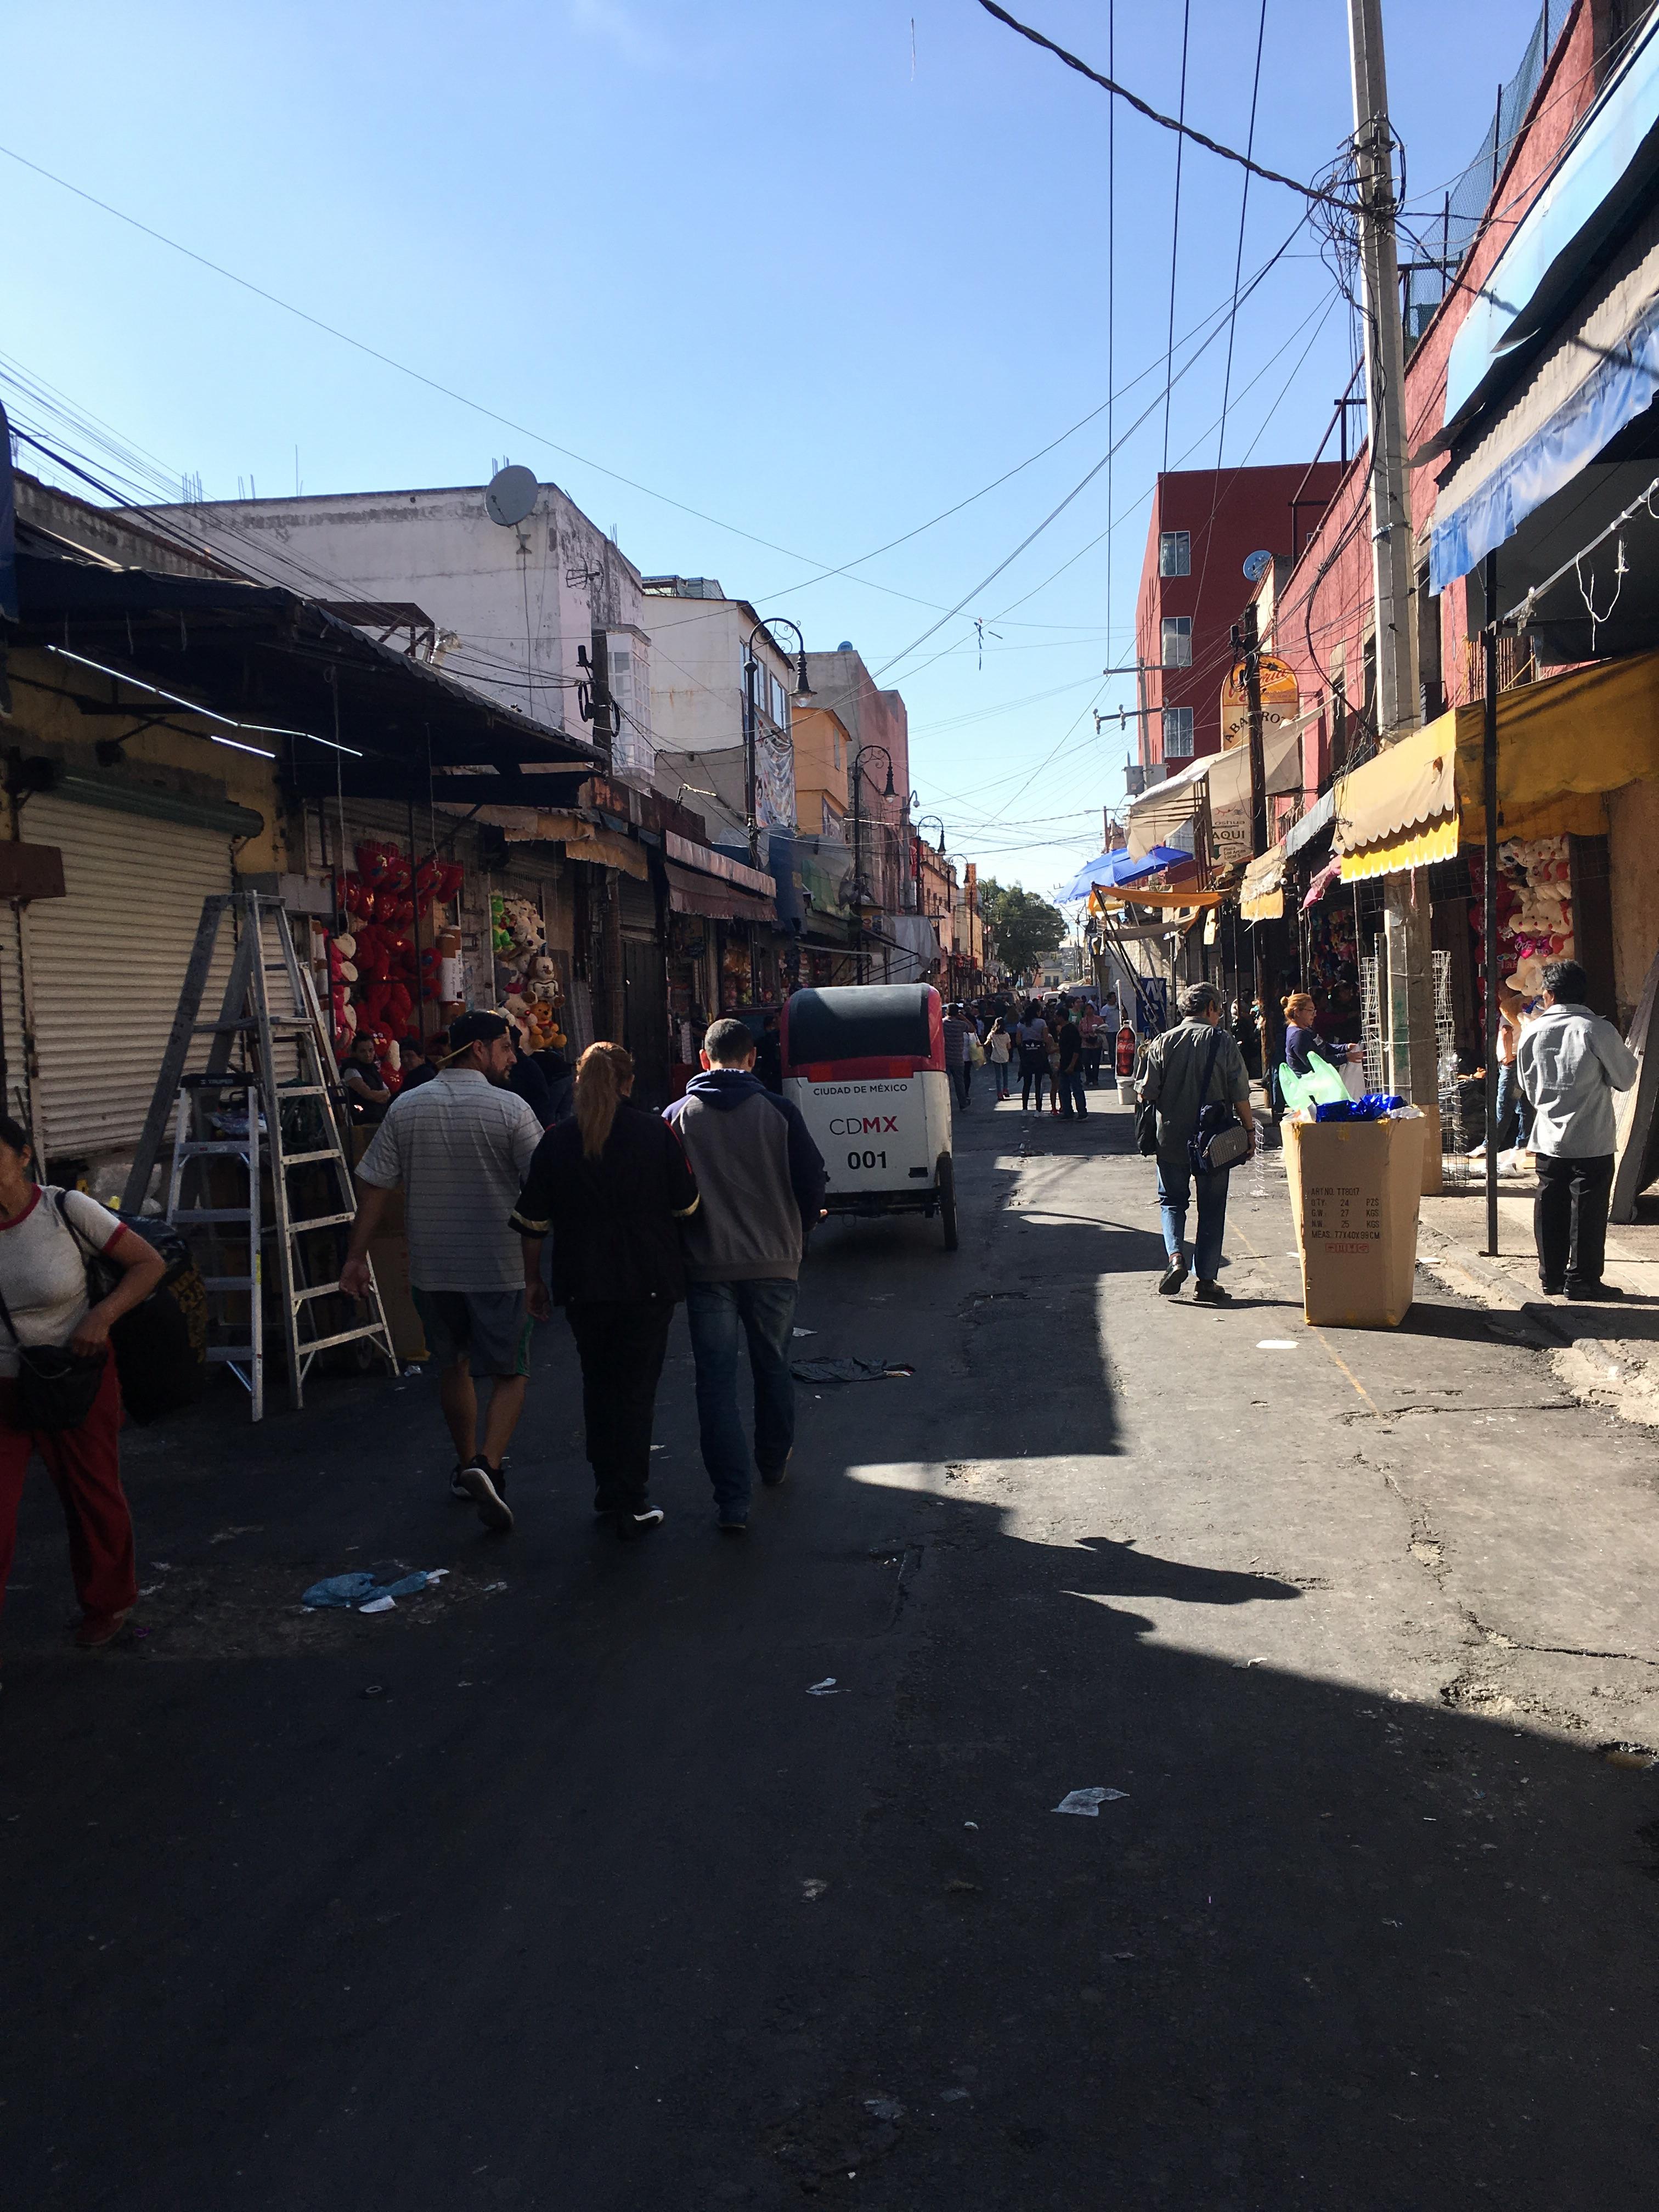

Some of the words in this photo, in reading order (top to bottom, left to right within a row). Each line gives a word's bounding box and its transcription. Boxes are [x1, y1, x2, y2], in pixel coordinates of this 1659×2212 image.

[1212, 831, 1245, 840] AQUI
[813, 1086, 850, 1096] CIUDAD
[870, 1084, 907, 1092] MÉXICO
[830, 1115, 899, 1136] CDMX
[848, 1150, 887, 1170] 001
[1340, 1199, 1349, 1207] 24
[1366, 1198, 1379, 1206] PZS
[1367, 1220, 1380, 1228] KGS
